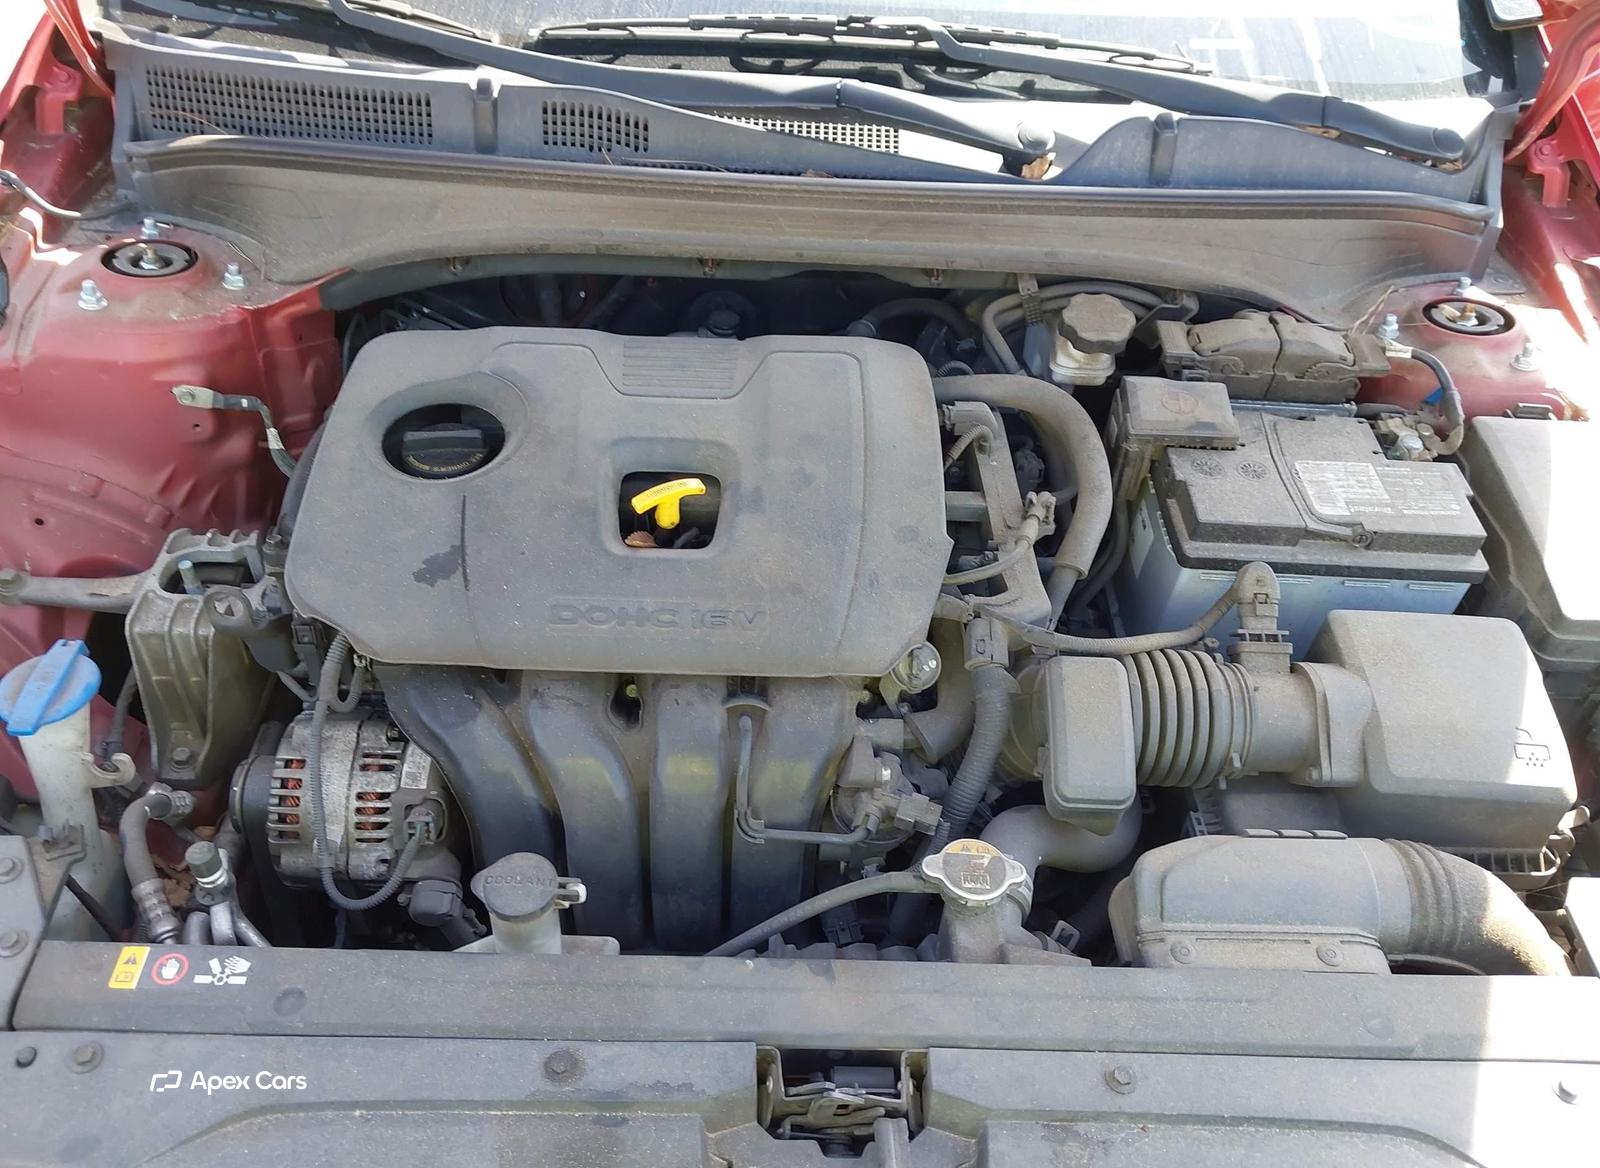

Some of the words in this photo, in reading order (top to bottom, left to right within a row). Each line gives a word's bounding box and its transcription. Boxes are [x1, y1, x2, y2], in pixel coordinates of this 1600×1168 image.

[549, 604, 681, 629] DOHC
[690, 609, 767, 632] 16V
[485, 875, 556, 887] COOLANT
